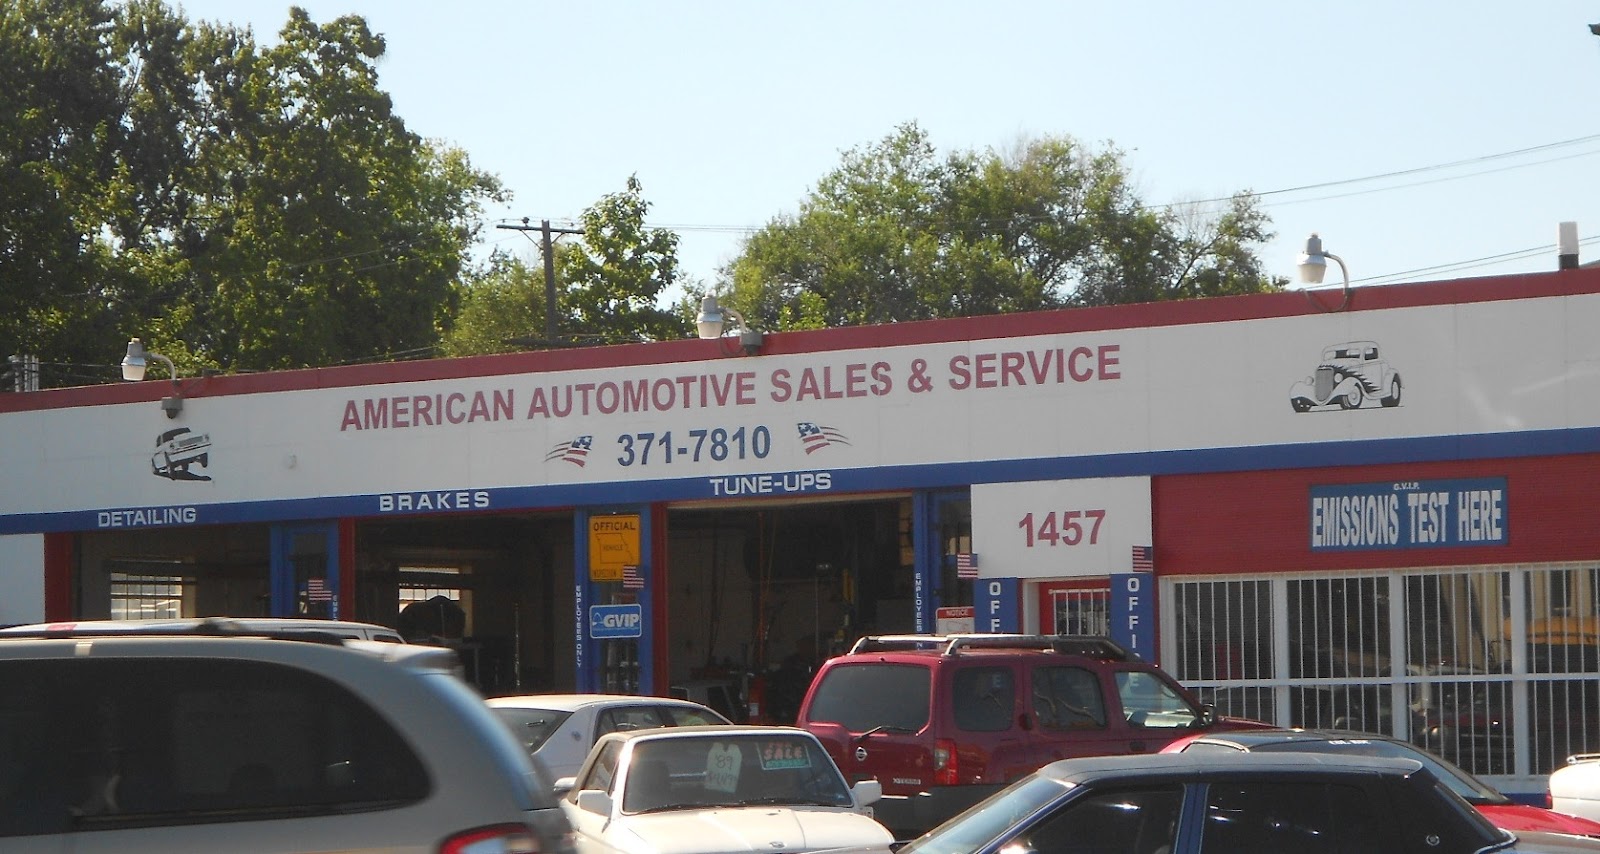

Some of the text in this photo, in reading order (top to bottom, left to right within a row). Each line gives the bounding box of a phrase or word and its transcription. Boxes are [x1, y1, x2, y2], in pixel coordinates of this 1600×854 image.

[340, 344, 1121, 431] AMERICAN AUTOMOTIVE SALES & SERVICE
[617, 425, 771, 467] 371-7810
[709, 473, 832, 495] TUNE-UPS
[379, 491, 490, 512] BRAKES
[97, 507, 196, 528] DETAILING
[593, 521, 636, 532] OFFICIAL
[1018, 509, 1106, 547] 1457
[1312, 489, 1502, 547] EMISSIONS TEST HERE
[915, 572, 923, 632] EMPLOYEES
[946, 608, 969, 617] NOTICE
[603, 613, 640, 627] GVIP
[1127, 577, 1141, 688] OFFIE
[763, 746, 803, 761] SALE
